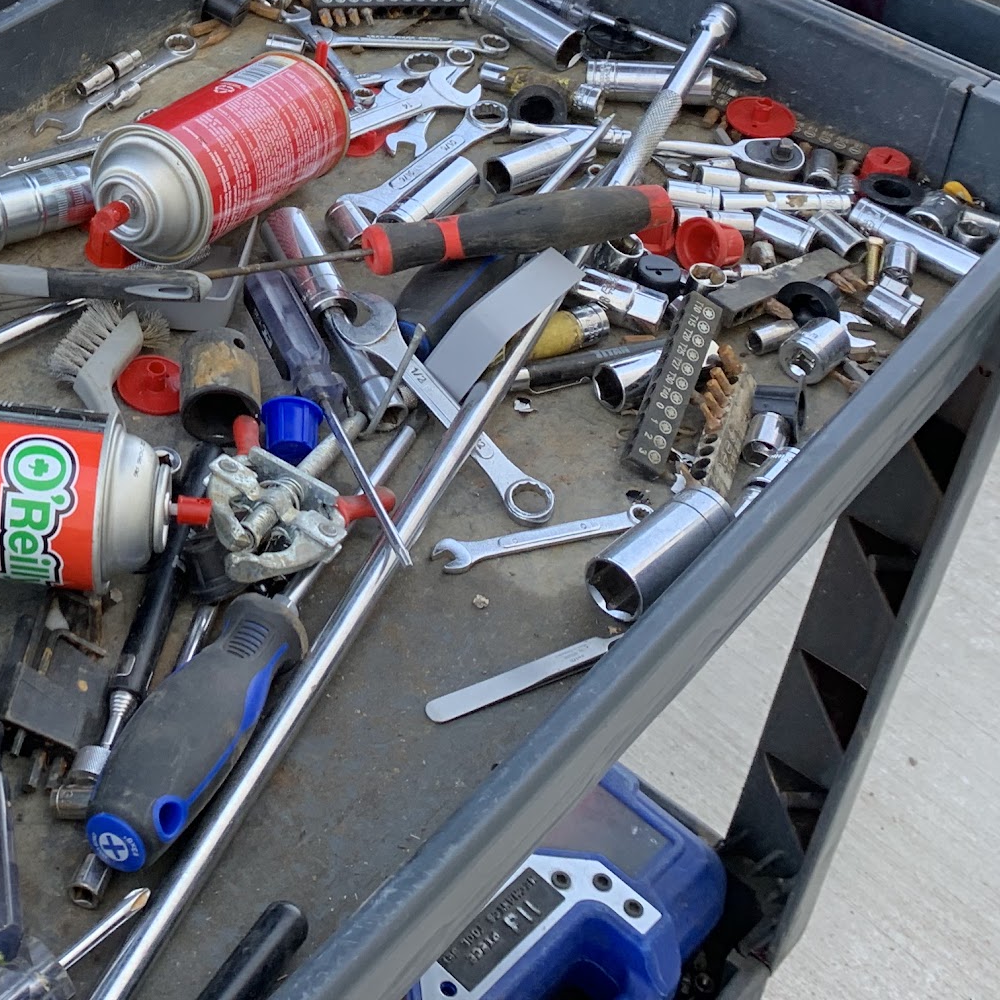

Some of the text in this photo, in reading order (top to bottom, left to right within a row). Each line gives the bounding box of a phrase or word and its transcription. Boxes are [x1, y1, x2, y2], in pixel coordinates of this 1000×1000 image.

[693, 300, 704, 314] T10
[687, 314, 699, 327] T15
[682, 328, 693, 342] T20
[676, 341, 688, 356] T25
[671, 356, 682, 371] T27
[411, 367, 427, 384] 1/2
[665, 371, 677, 385] T30
[660, 385, 671, 399] T40
[656, 401, 665, 410] 0
[644, 431, 654, 440] 2
[638, 447, 648, 456] 3
[8, 444, 67, 582] O'Reill
